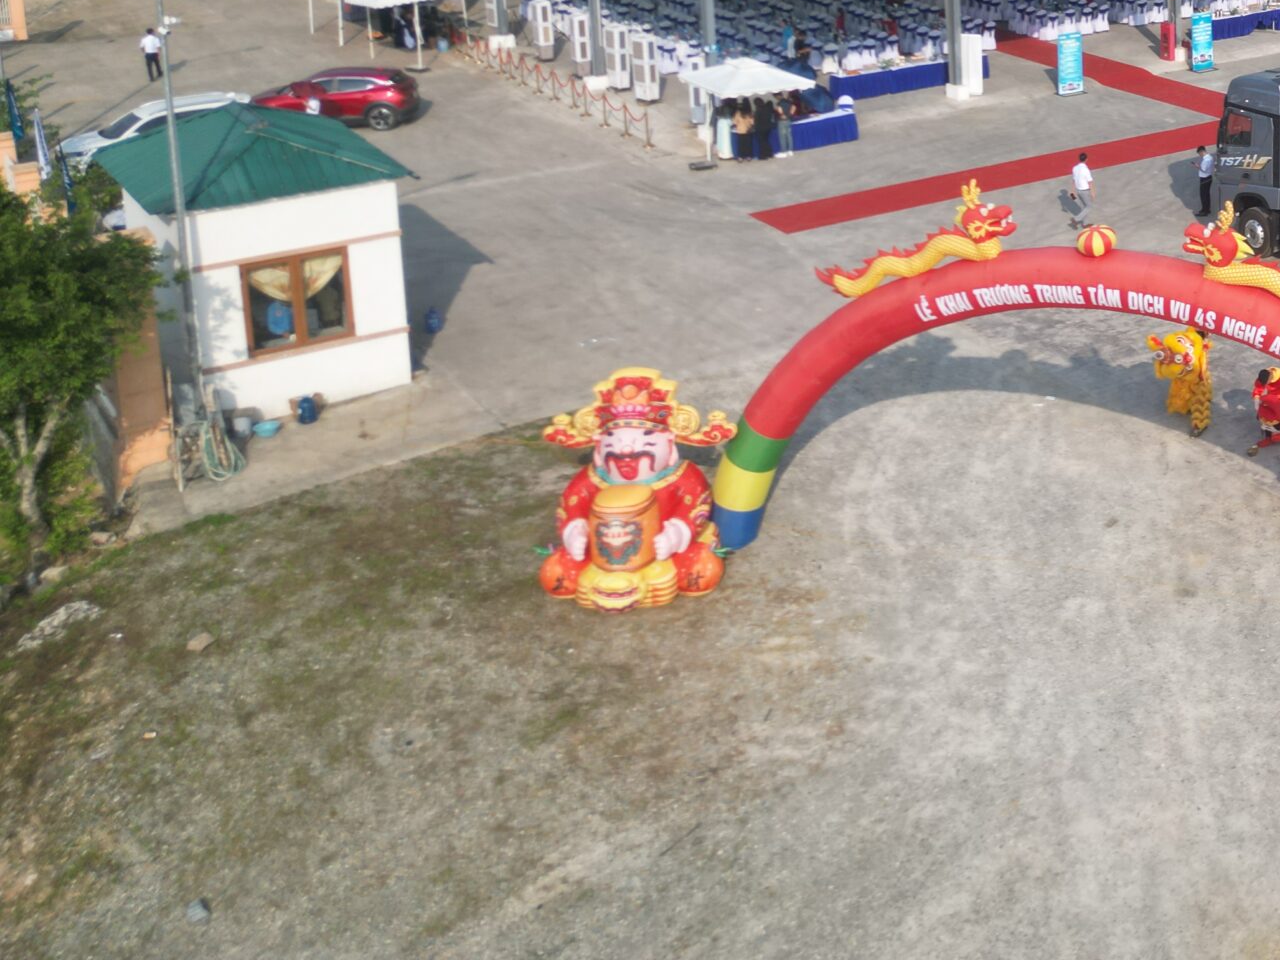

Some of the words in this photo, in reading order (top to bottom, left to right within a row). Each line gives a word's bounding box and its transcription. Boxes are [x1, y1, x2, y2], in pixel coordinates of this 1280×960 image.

[935, 291, 974, 317] KHAI
[1033, 284, 1085, 305] TRUNG
[1087, 283, 1122, 309] TÂM
[1127, 290, 1165, 316] DỊCH
[1169, 299, 1191, 324] VỤ
[1194, 307, 1217, 330] 4S
[1221, 316, 1268, 349] NGHỆ
